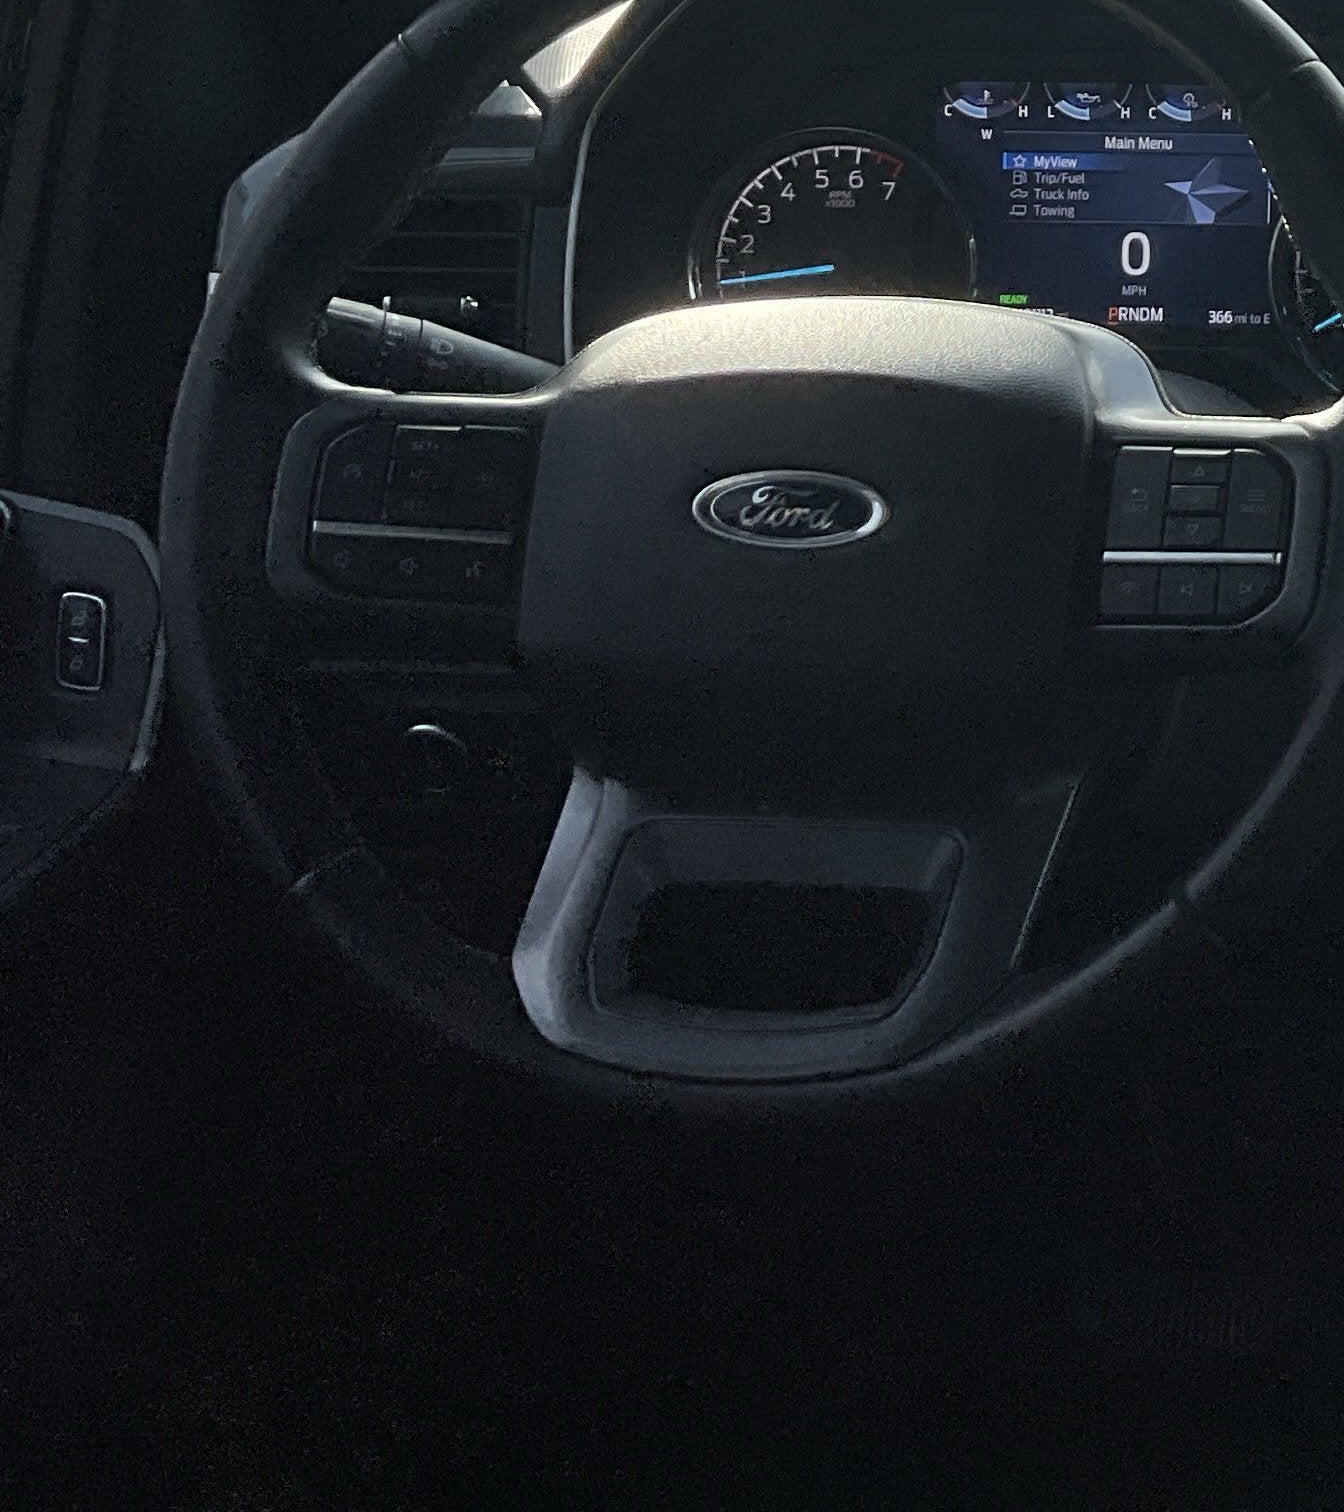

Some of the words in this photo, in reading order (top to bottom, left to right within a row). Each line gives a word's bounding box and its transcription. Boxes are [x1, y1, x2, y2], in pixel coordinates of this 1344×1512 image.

[944, 105, 953, 117] C
[1018, 104, 1028, 117] H
[1048, 106, 1055, 118] L
[1121, 106, 1131, 119] H
[1149, 107, 1157, 119] C
[1222, 108, 1231, 120] H
[981, 128, 993, 140] W
[1105, 136, 1135, 150] Main
[1138, 137, 1173, 151] Menu
[1034, 155, 1078, 169] MyView
[815, 169, 830, 188] 5
[848, 170, 864, 188] 6
[1033, 172, 1085, 186] Trip/Fuel
[780, 182, 796, 201] 4
[882, 182, 896, 200] 7
[1034, 188, 1064, 200] Truck
[1068, 188, 1089, 201] Info
[757, 205, 771, 223] 3
[1034, 204, 1075, 219] Towing
[739, 234, 755, 254] 2
[1121, 232, 1151, 277] 0
[1121, 285, 1147, 296] MPH
[1209, 310, 1233, 323] 366
[1250, 311, 1261, 324] to
[1264, 311, 1271, 323] E
[740, 485, 841, 530] Ford
